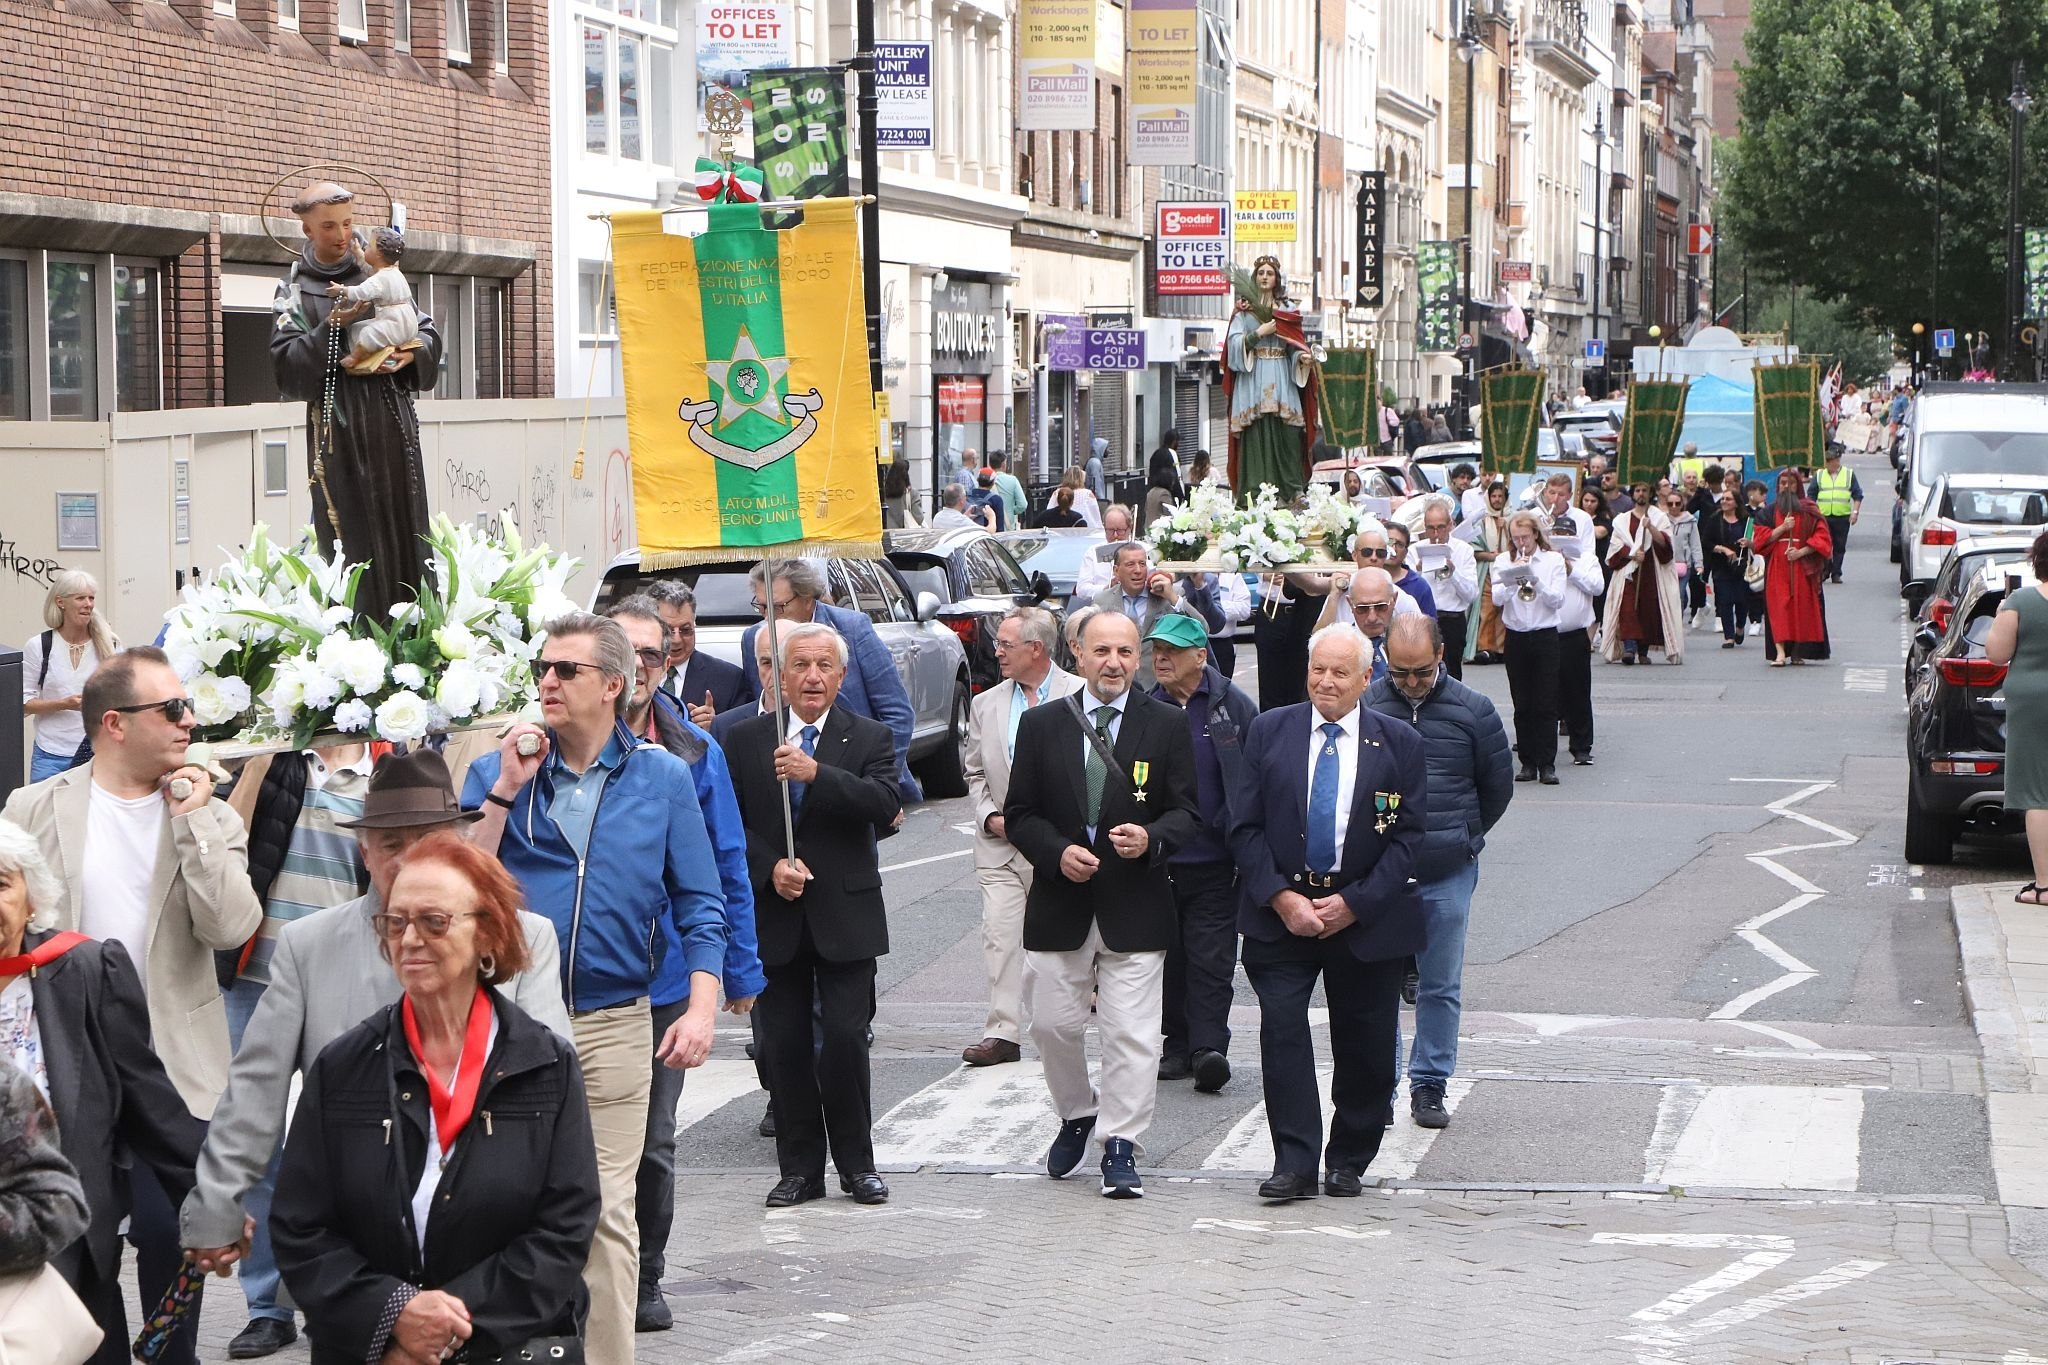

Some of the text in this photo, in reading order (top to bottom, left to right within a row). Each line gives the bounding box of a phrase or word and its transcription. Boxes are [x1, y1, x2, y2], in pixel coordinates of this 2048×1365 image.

[711, 8, 776, 20] OFFICES
[1030, 6, 1089, 16] Workshops
[705, 23, 781, 39] TO LET
[1049, 25, 1070, 33] 2,000
[1138, 28, 1189, 41] TO LET
[874, 47, 926, 59] WELLERY
[878, 61, 910, 72] UNIT
[1138, 58, 1190, 68] Workshops
[1030, 78, 1086, 91] Pall Mall
[893, 89, 928, 100] LEASE
[1028, 95, 1043, 103] 020
[1068, 95, 1088, 103] 7221
[1139, 121, 1187, 131] Pall Mall
[882, 130, 904, 139] 7224
[907, 130, 927, 139] 0101
[1236, 199, 1290, 210] TO LET
[1259, 212, 1264, 220] &
[1266, 212, 1295, 220] COUTTS
[1165, 211, 1215, 233] goodsir
[1363, 176, 1377, 283] RAPHAEL
[1165, 242, 1222, 252] OFFICES
[1162, 255, 1225, 267] TO LET
[1159, 275, 1177, 284] 020
[1180, 275, 1202, 284] 7566
[937, 312, 984, 357] BOUTIQUE
[1090, 331, 1139, 346] CASH
[1104, 346, 1124, 354] FOR
[1089, 355, 1139, 368] GOLD
[756, 494, 795, 510] M.D.L.
[766, 507, 808, 524] UNITO
